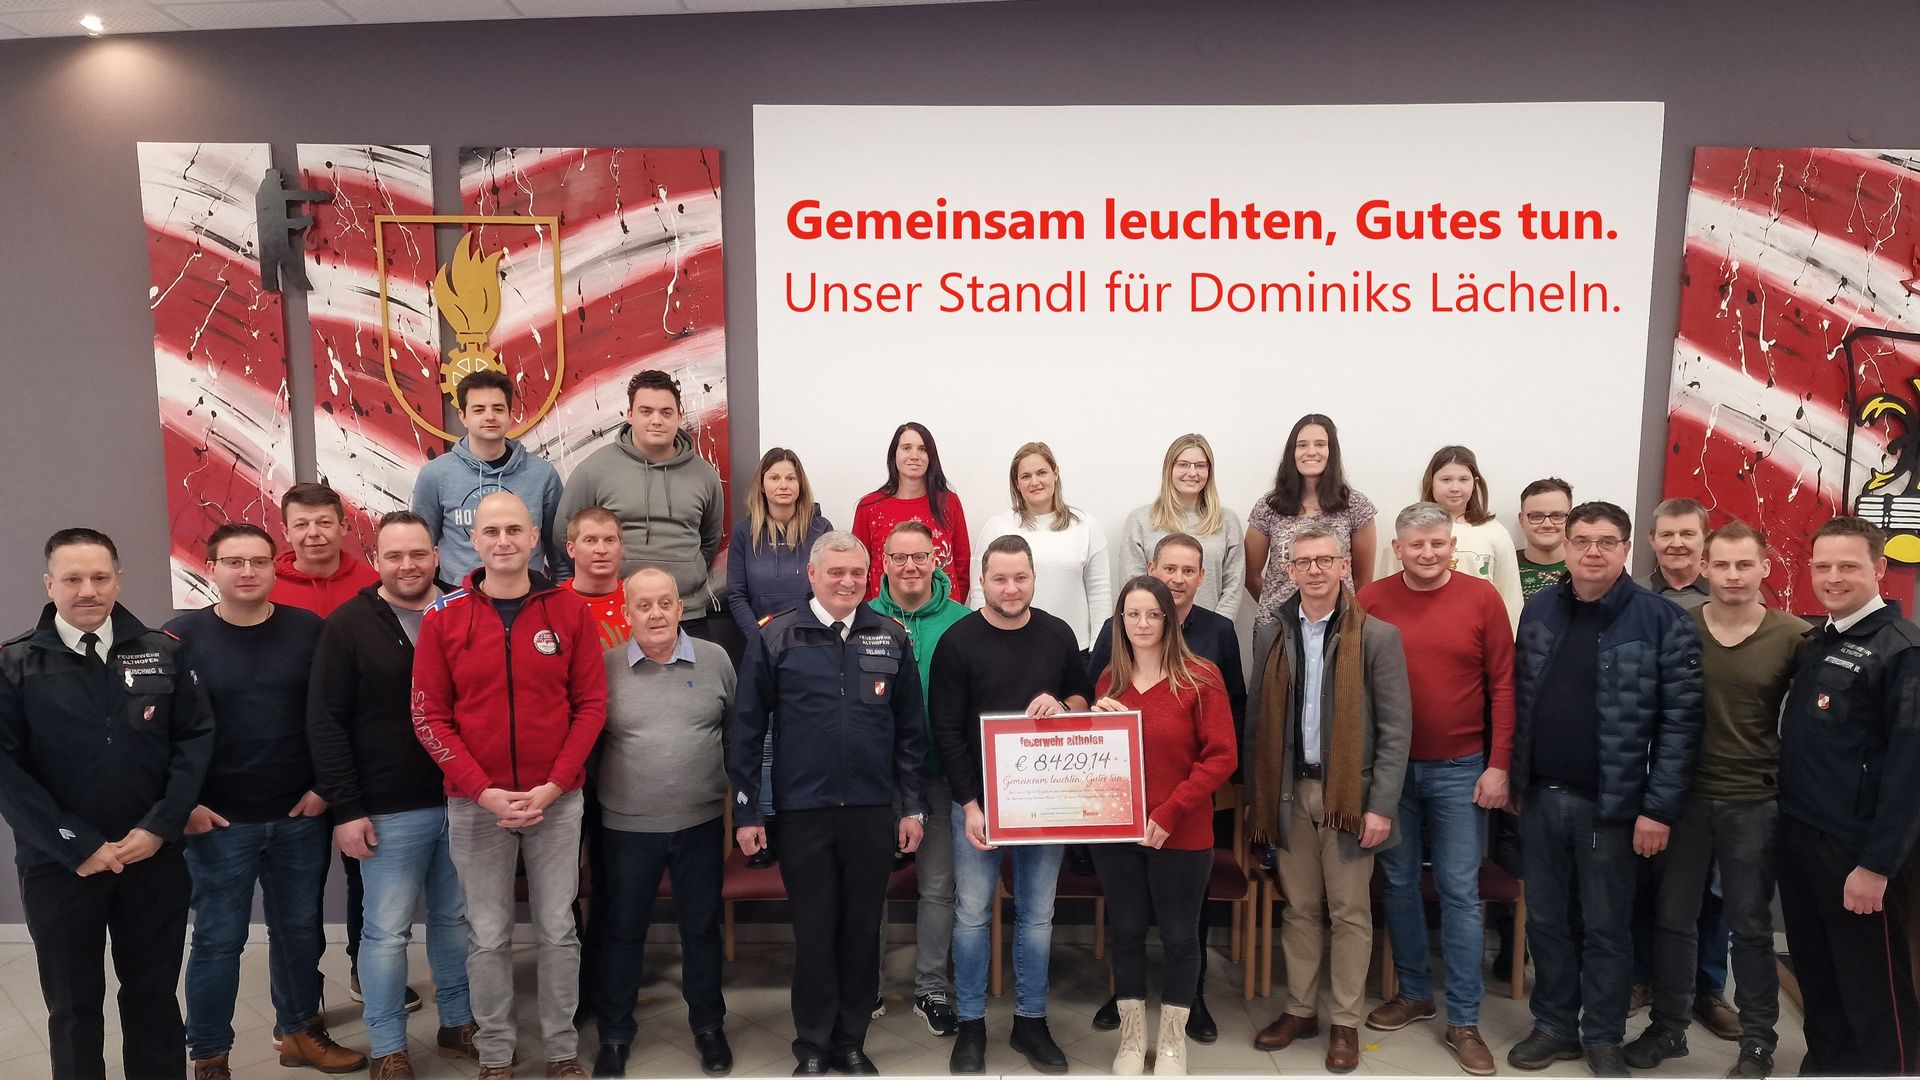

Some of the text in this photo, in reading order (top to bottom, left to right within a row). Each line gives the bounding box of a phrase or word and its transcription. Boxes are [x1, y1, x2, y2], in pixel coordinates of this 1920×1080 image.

[455, 508, 476, 526] HO
[1020, 734, 1105, 748] feuerwehr althofen
[1002, 775, 1048, 790] Gemeinsam
[1085, 772, 1107, 788] Gutes
